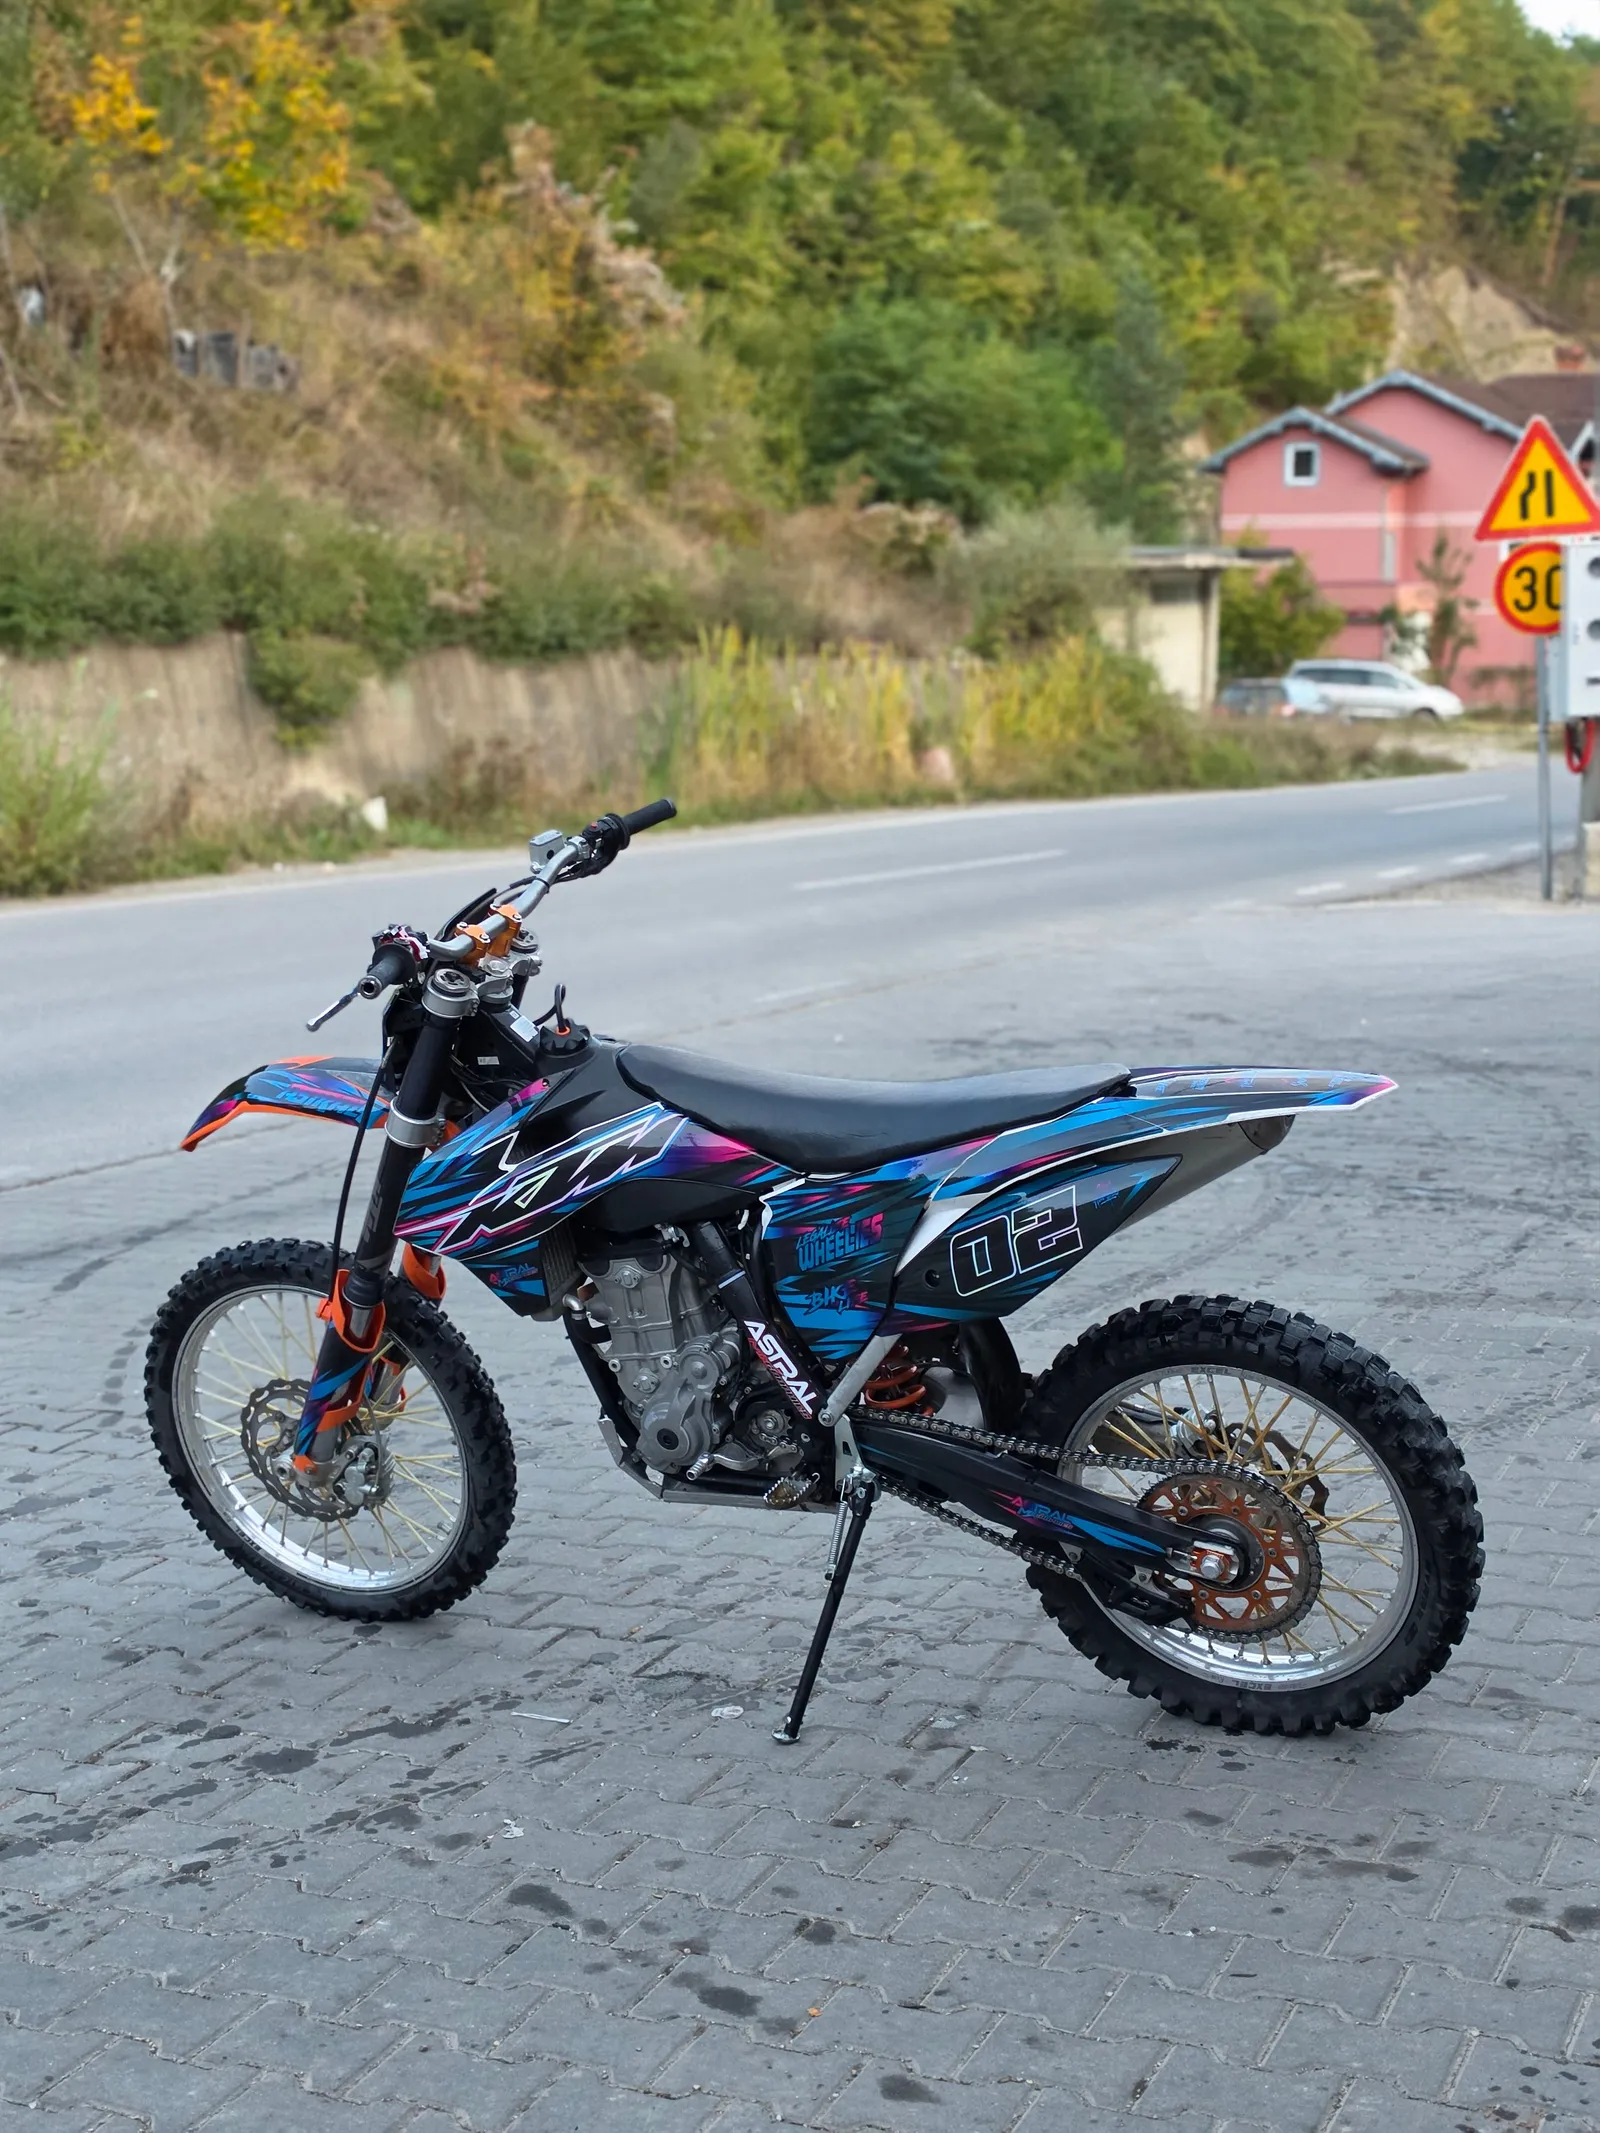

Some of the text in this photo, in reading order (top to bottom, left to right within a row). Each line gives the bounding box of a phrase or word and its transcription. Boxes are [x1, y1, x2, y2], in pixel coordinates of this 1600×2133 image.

[798, 1212, 885, 1272] WHEELIES
[949, 1185, 1084, 1297] 02
[743, 1320, 818, 1415] ASTRAL
[1190, 1365, 1233, 1374] EXCEL
[1231, 1679, 1273, 1691] EXCEL
